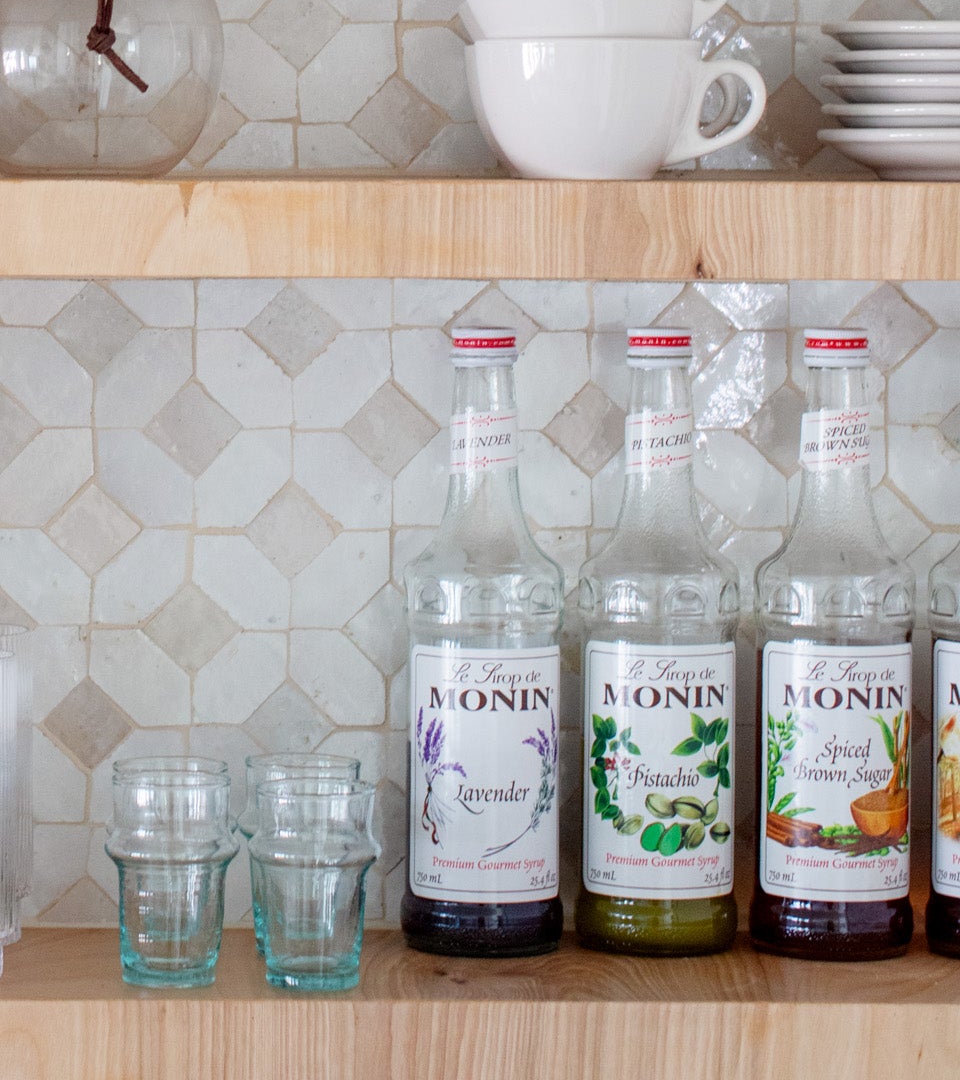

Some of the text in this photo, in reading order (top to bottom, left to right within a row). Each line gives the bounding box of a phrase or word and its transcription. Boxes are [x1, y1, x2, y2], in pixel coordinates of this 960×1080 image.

[632, 431, 692, 450] PITACHIO
[823, 423, 866, 438] SPICED
[444, 662, 541, 688] Le Sirop de
[617, 659, 716, 685] Le Sirop de
[799, 660, 895, 687] Le Sirop de
[429, 686, 550, 712] MONIN
[603, 683, 725, 709] MONIN
[783, 684, 905, 710] MONIN
[816, 734, 872, 764] Spiced
[626, 763, 700, 789] Pistachio
[793, 758, 893, 788] Brown Sugar
[453, 780, 530, 815] Lavender
[432, 856, 545, 873] Premium Gourmet Syrup
[606, 852, 720, 870] Premium Gourmet Syrup
[785, 855, 899, 873] Premium Gourmet Syrup
